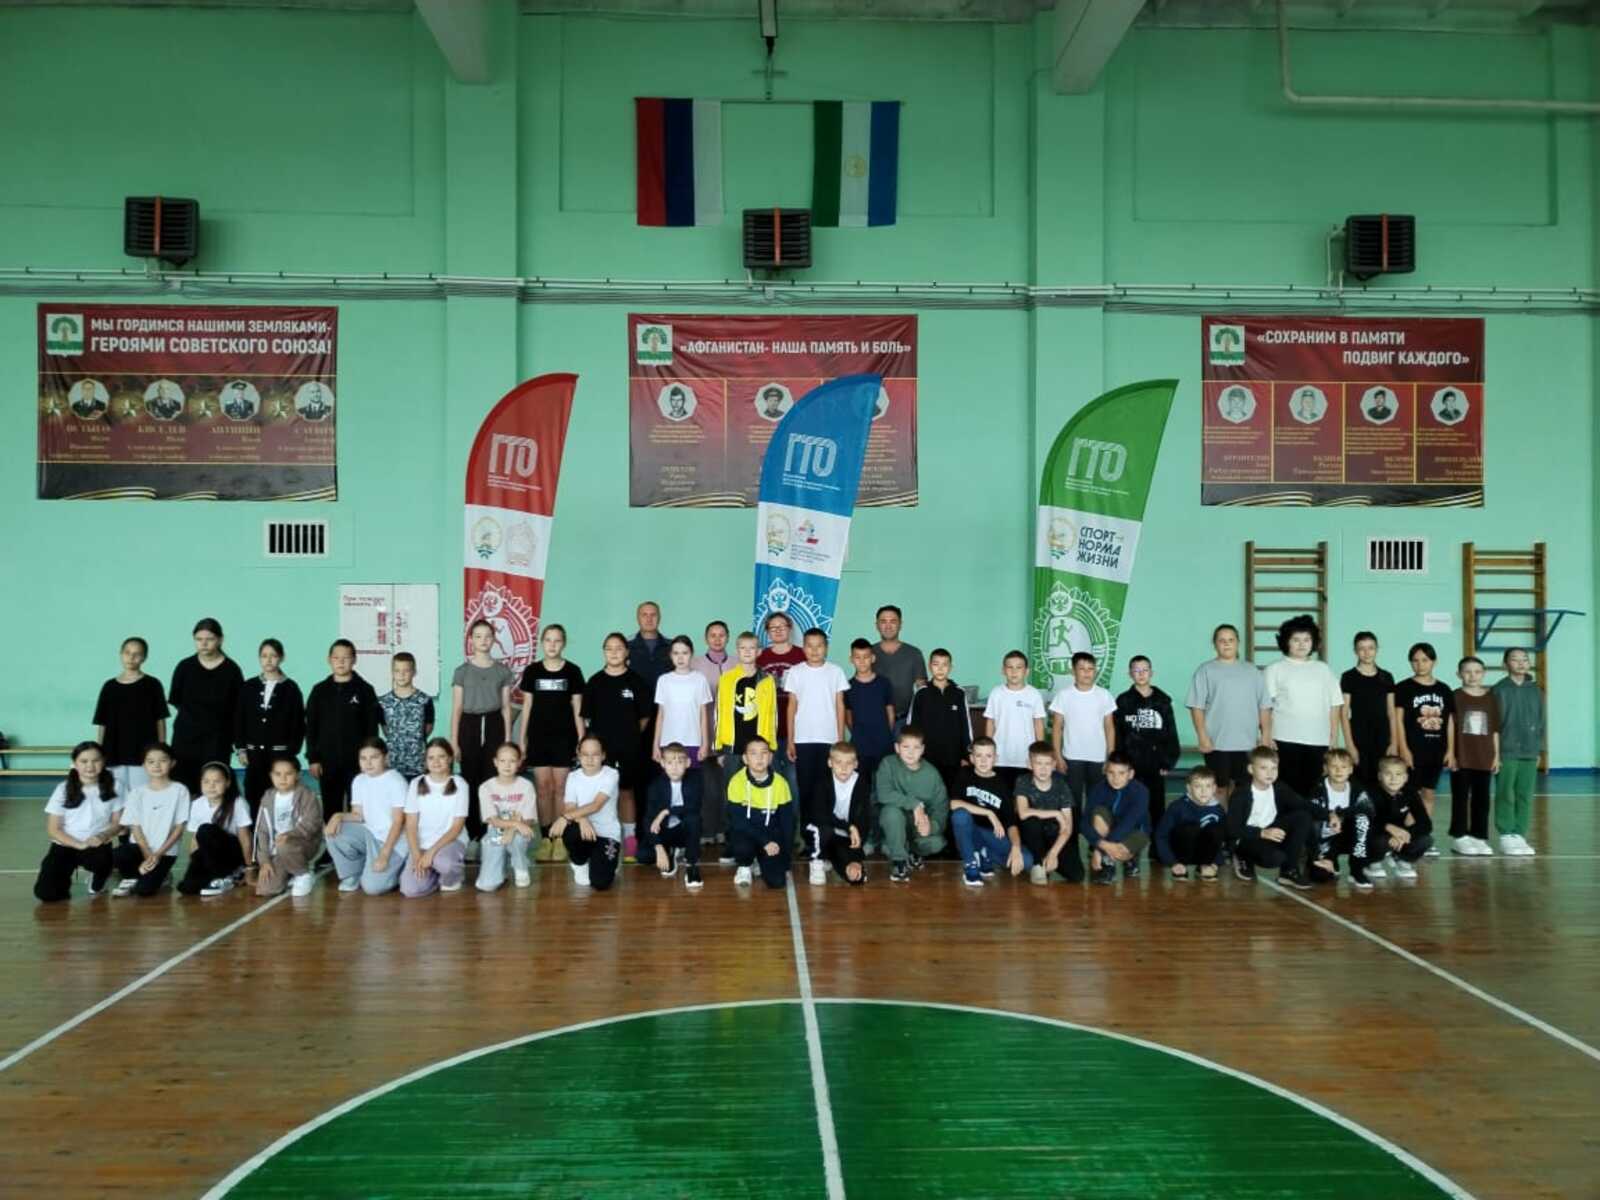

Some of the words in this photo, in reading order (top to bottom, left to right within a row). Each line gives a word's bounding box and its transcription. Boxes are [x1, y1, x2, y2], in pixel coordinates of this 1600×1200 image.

[91, 318, 113, 331] МЫ
[116, 318, 184, 333] ГОРДИМСЯ
[187, 319, 245, 332] НАШИМИ
[248, 320, 331, 333] ЗЕМЛЯКАМИ-
[91, 336, 165, 353] ГЕРОЯМИ
[169, 337, 268, 354] СОВЕТСКОГО
[272, 338, 332, 354] СОЮЗА!
[1257, 330, 1336, 344] «СОХРАНИМ
[1339, 331, 1348, 344] В
[1352, 331, 1405, 345] ПАМЯТИ
[772, 341, 807, 354] НАША
[810, 341, 858, 354] ПАМЯТЬ
[861, 341, 869, 354] И
[872, 341, 911, 354] БОЛЬ»
[1343, 350, 1395, 366] ПОДВИГ
[1398, 351, 1470, 367] КАЖДОГО»
[488, 433, 539, 478] ГТО
[784, 432, 837, 478] ГТО
[1067, 436, 1128, 482] ГТО
[1078, 537, 1121, 556] НОРМА
[1077, 550, 1118, 569] ЖИЗНИ
